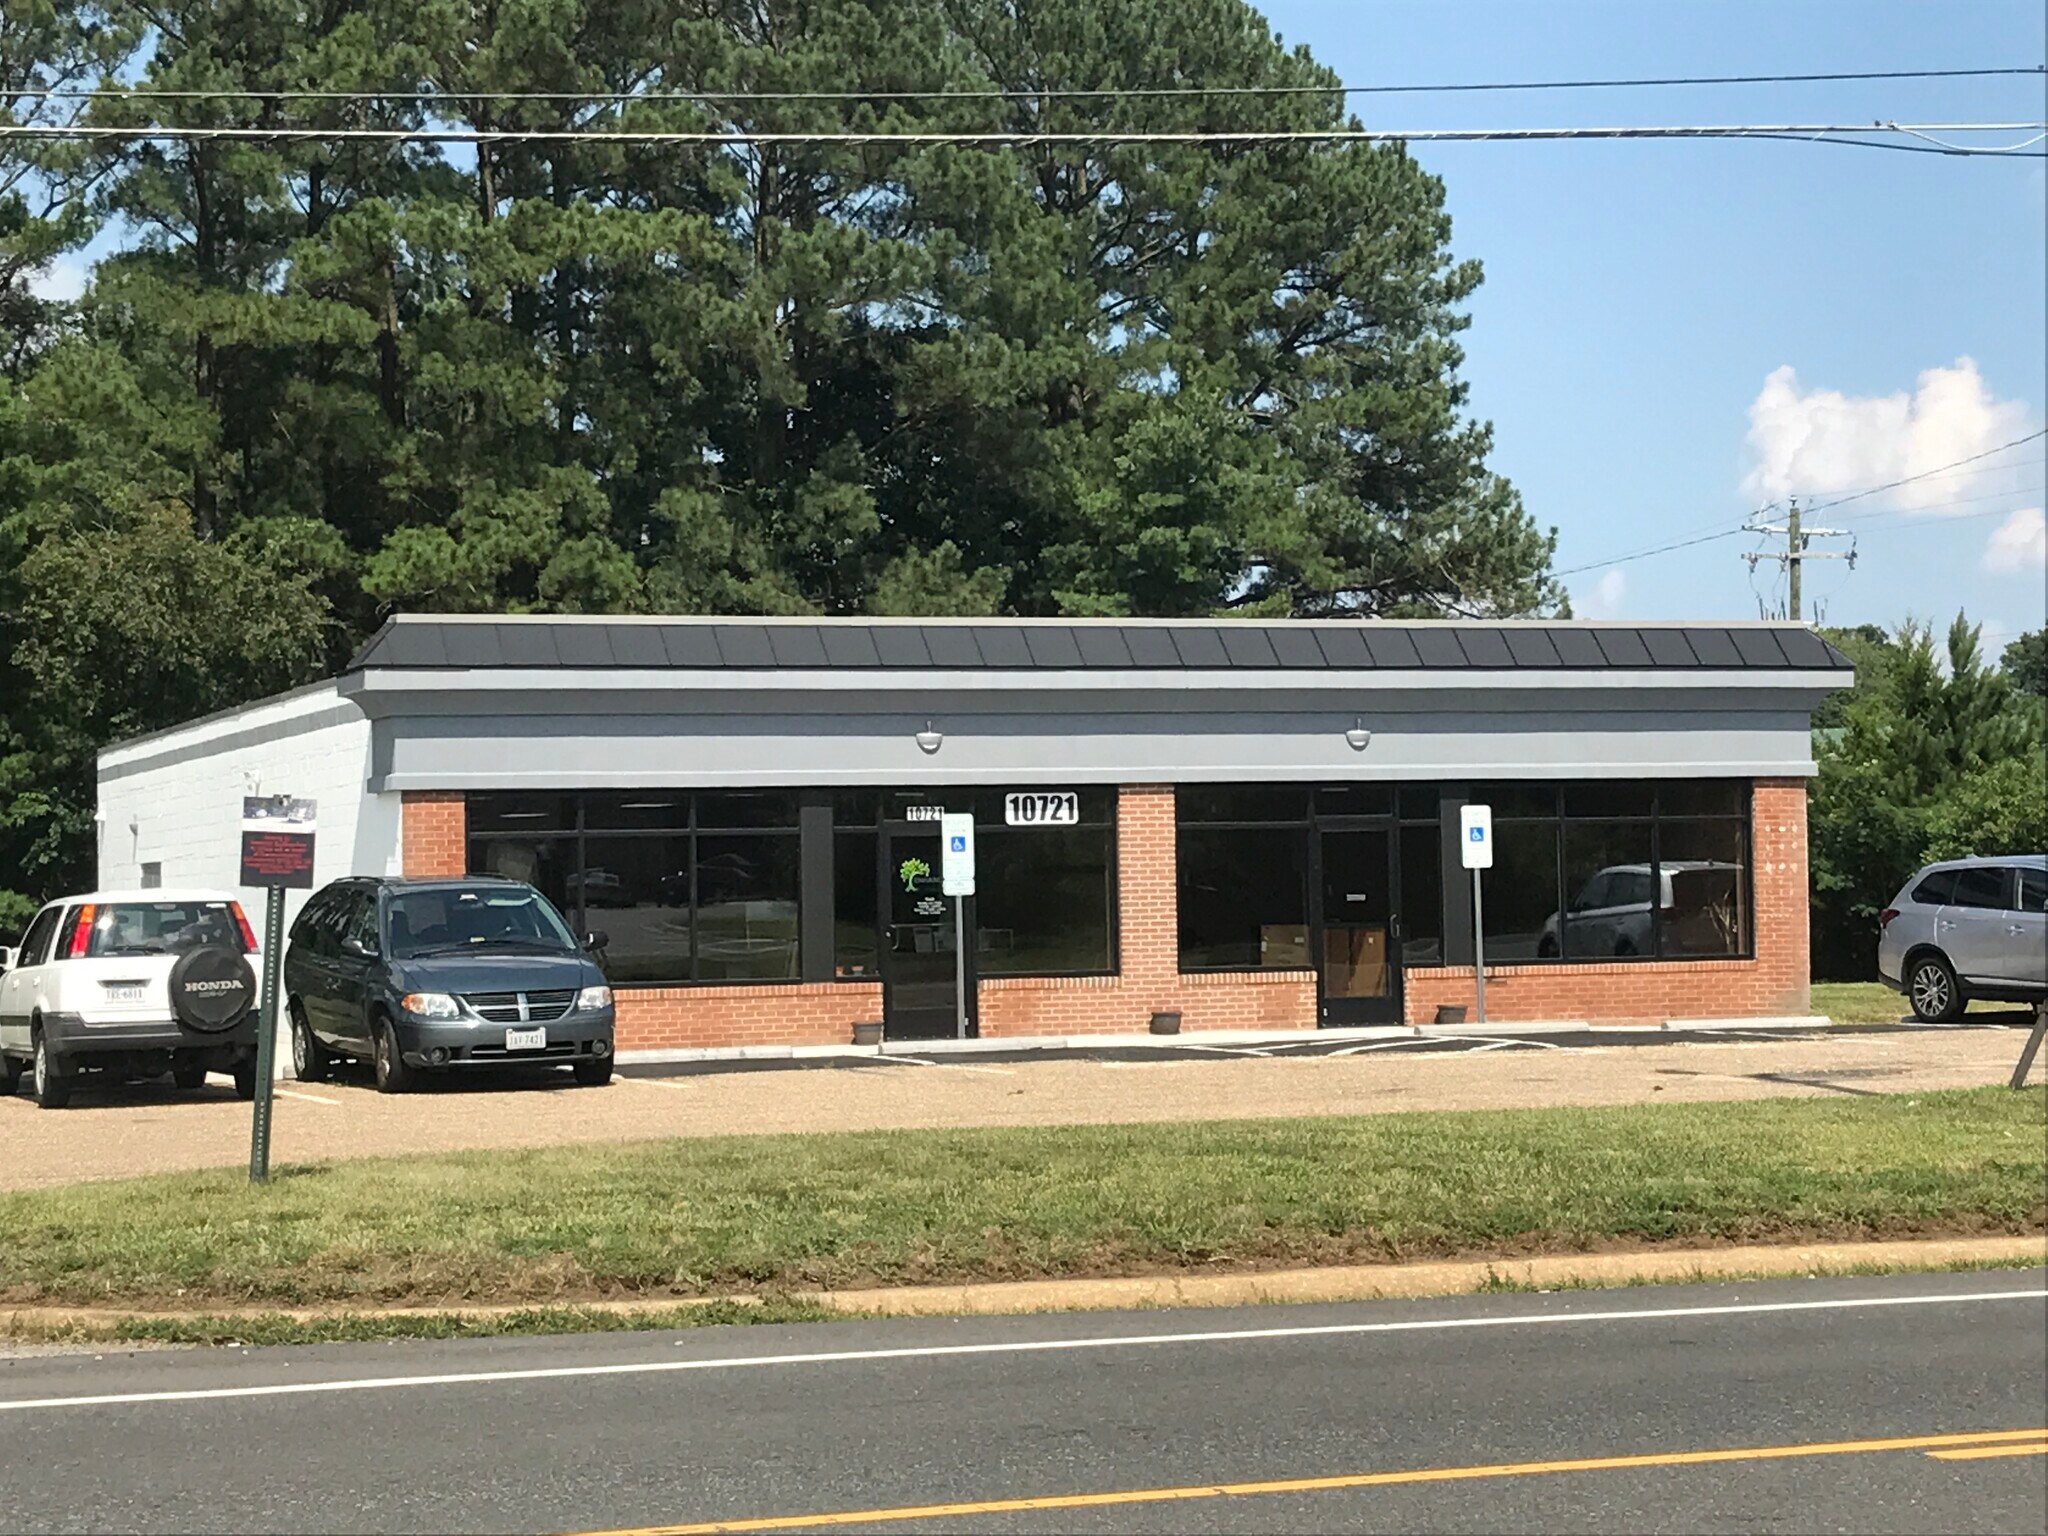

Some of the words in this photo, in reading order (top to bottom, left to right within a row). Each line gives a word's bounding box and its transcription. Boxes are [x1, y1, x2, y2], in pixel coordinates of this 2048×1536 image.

[909, 806, 943, 820] 10721
[1009, 795, 1075, 821] 10721
[185, 980, 244, 991] HONDA
